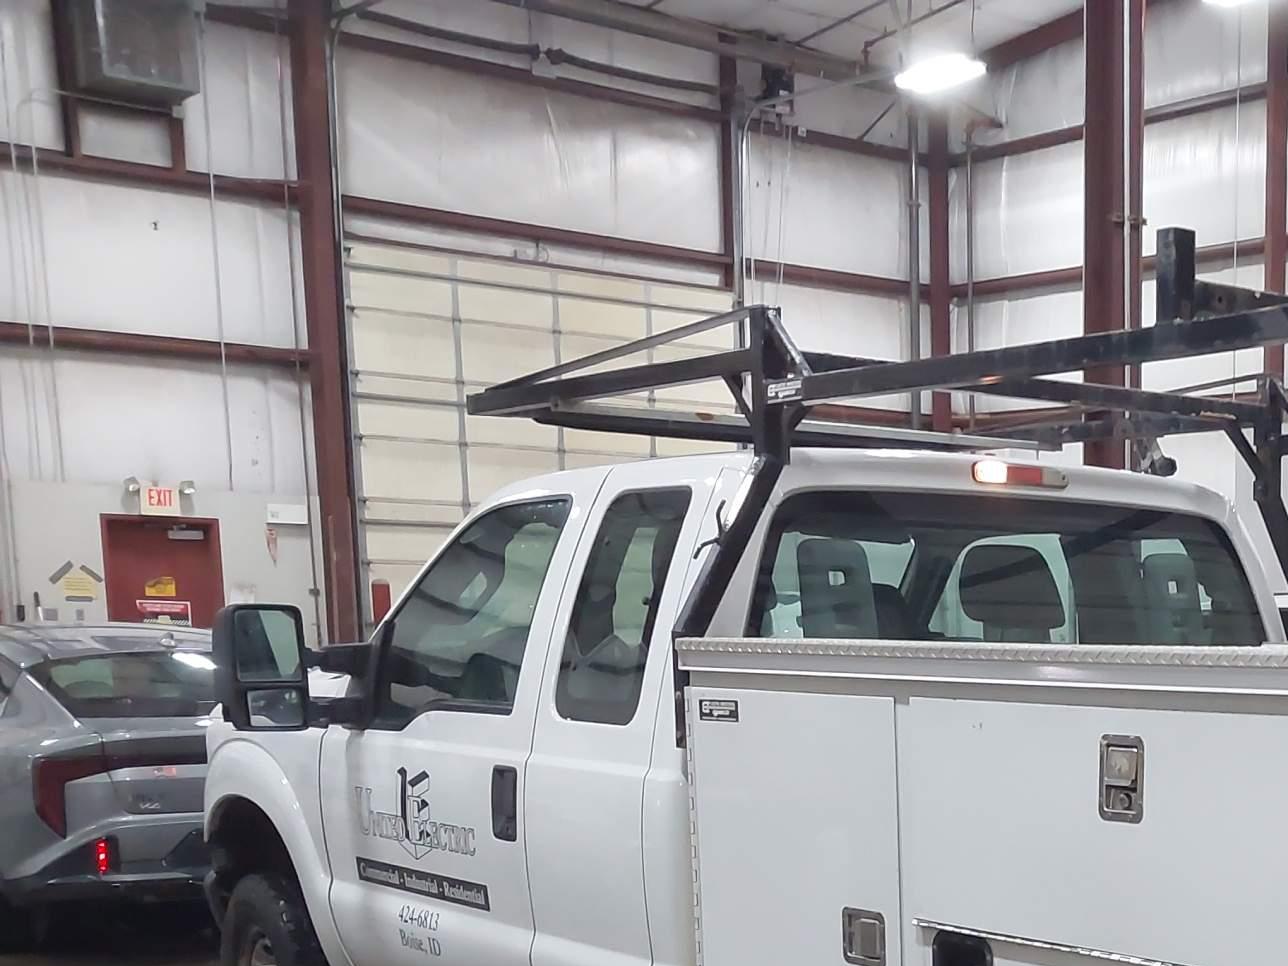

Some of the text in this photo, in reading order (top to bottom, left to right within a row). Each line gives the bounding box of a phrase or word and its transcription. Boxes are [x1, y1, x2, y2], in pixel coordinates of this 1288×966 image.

[147, 488, 173, 507] EXIT
[360, 861, 400, 886] Ccial
[403, 872, 439, 895] Idrial
[398, 904, 440, 932] 424-6813
[427, 936, 441, 957] ID
